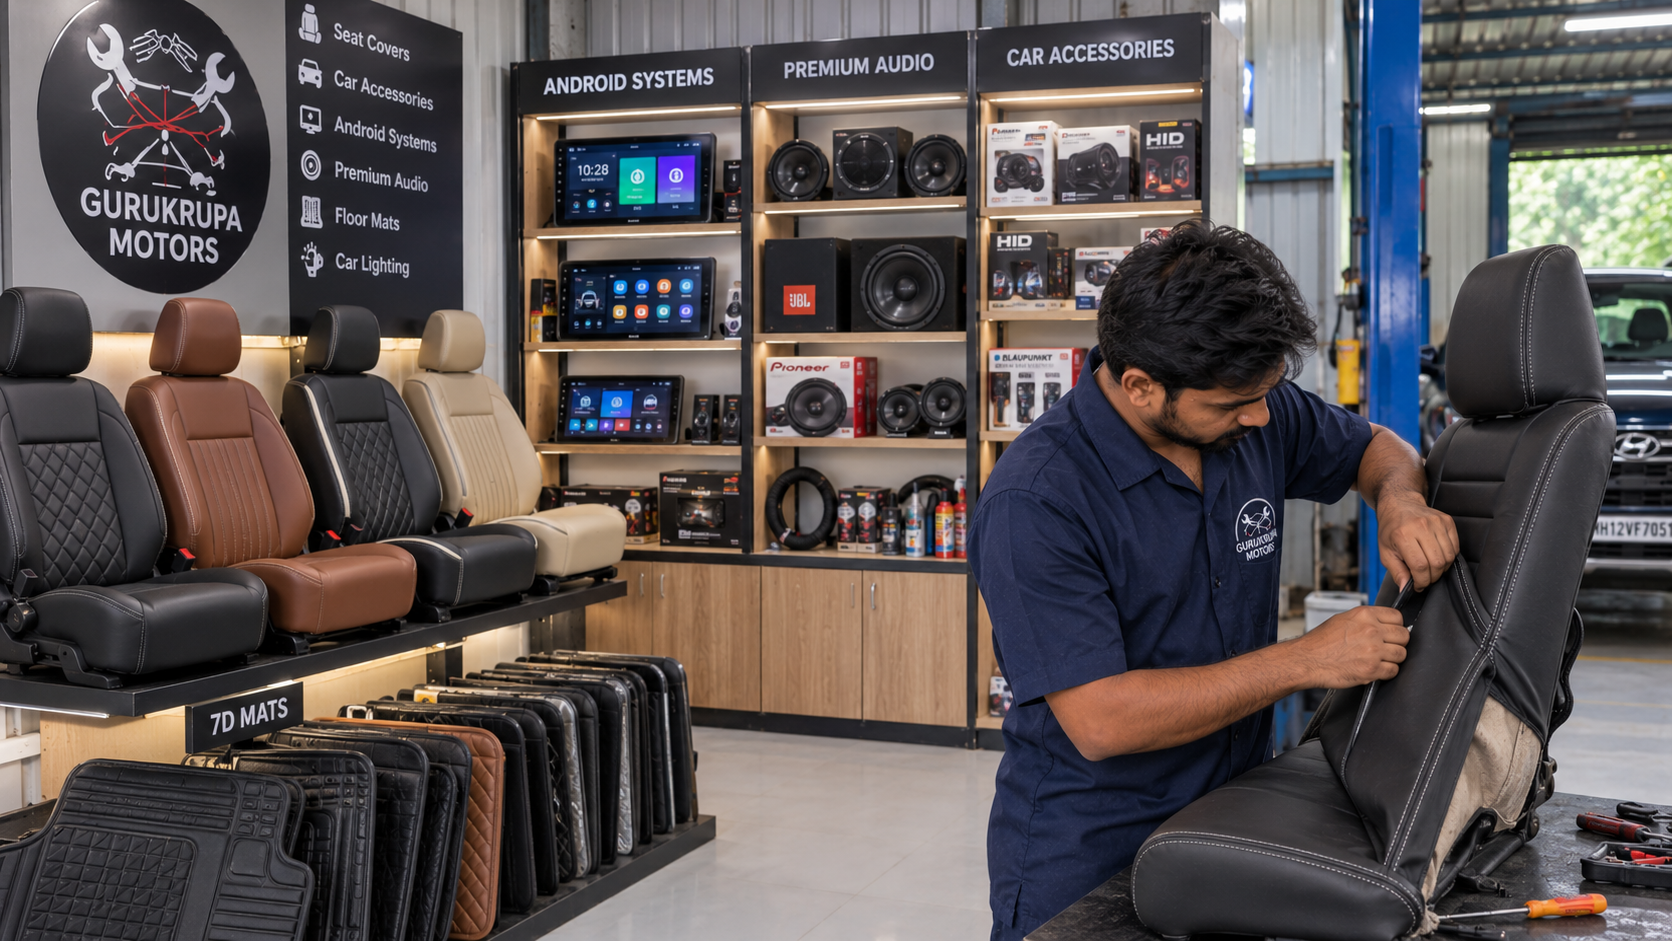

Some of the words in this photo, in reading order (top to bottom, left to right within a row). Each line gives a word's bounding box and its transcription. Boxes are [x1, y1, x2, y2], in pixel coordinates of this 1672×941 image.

[333, 23, 364, 46] Seat
[366, 32, 410, 62] Covers
[1006, 48, 1044, 67] CAR
[1049, 38, 1175, 64] ACCESSORIES
[784, 58, 870, 79] PREMIUM
[874, 53, 935, 74] AUDIO
[334, 70, 357, 90] Car
[360, 77, 434, 111] Accessories
[543, 73, 627, 95] ANDROID
[631, 67, 714, 90] SYSTEMS
[334, 115, 386, 141] Android
[388, 125, 437, 153] Systems
[1145, 131, 1185, 147] HID
[335, 161, 392, 186] Premium
[395, 171, 429, 193] Audio
[577, 163, 609, 177] 10:28
[80, 187, 243, 232] GURUKRUPA
[335, 207, 368, 228] Floor
[371, 212, 400, 231] Mats
[109, 227, 219, 264] MOTORS
[997, 234, 1033, 248] HID
[335, 253, 358, 271] Car
[361, 255, 410, 279] Lighting
[789, 293, 811, 308] JBL
[770, 361, 830, 373] Pioneer
[210, 710, 235, 735] 7D
[240, 697, 288, 728] MATS
